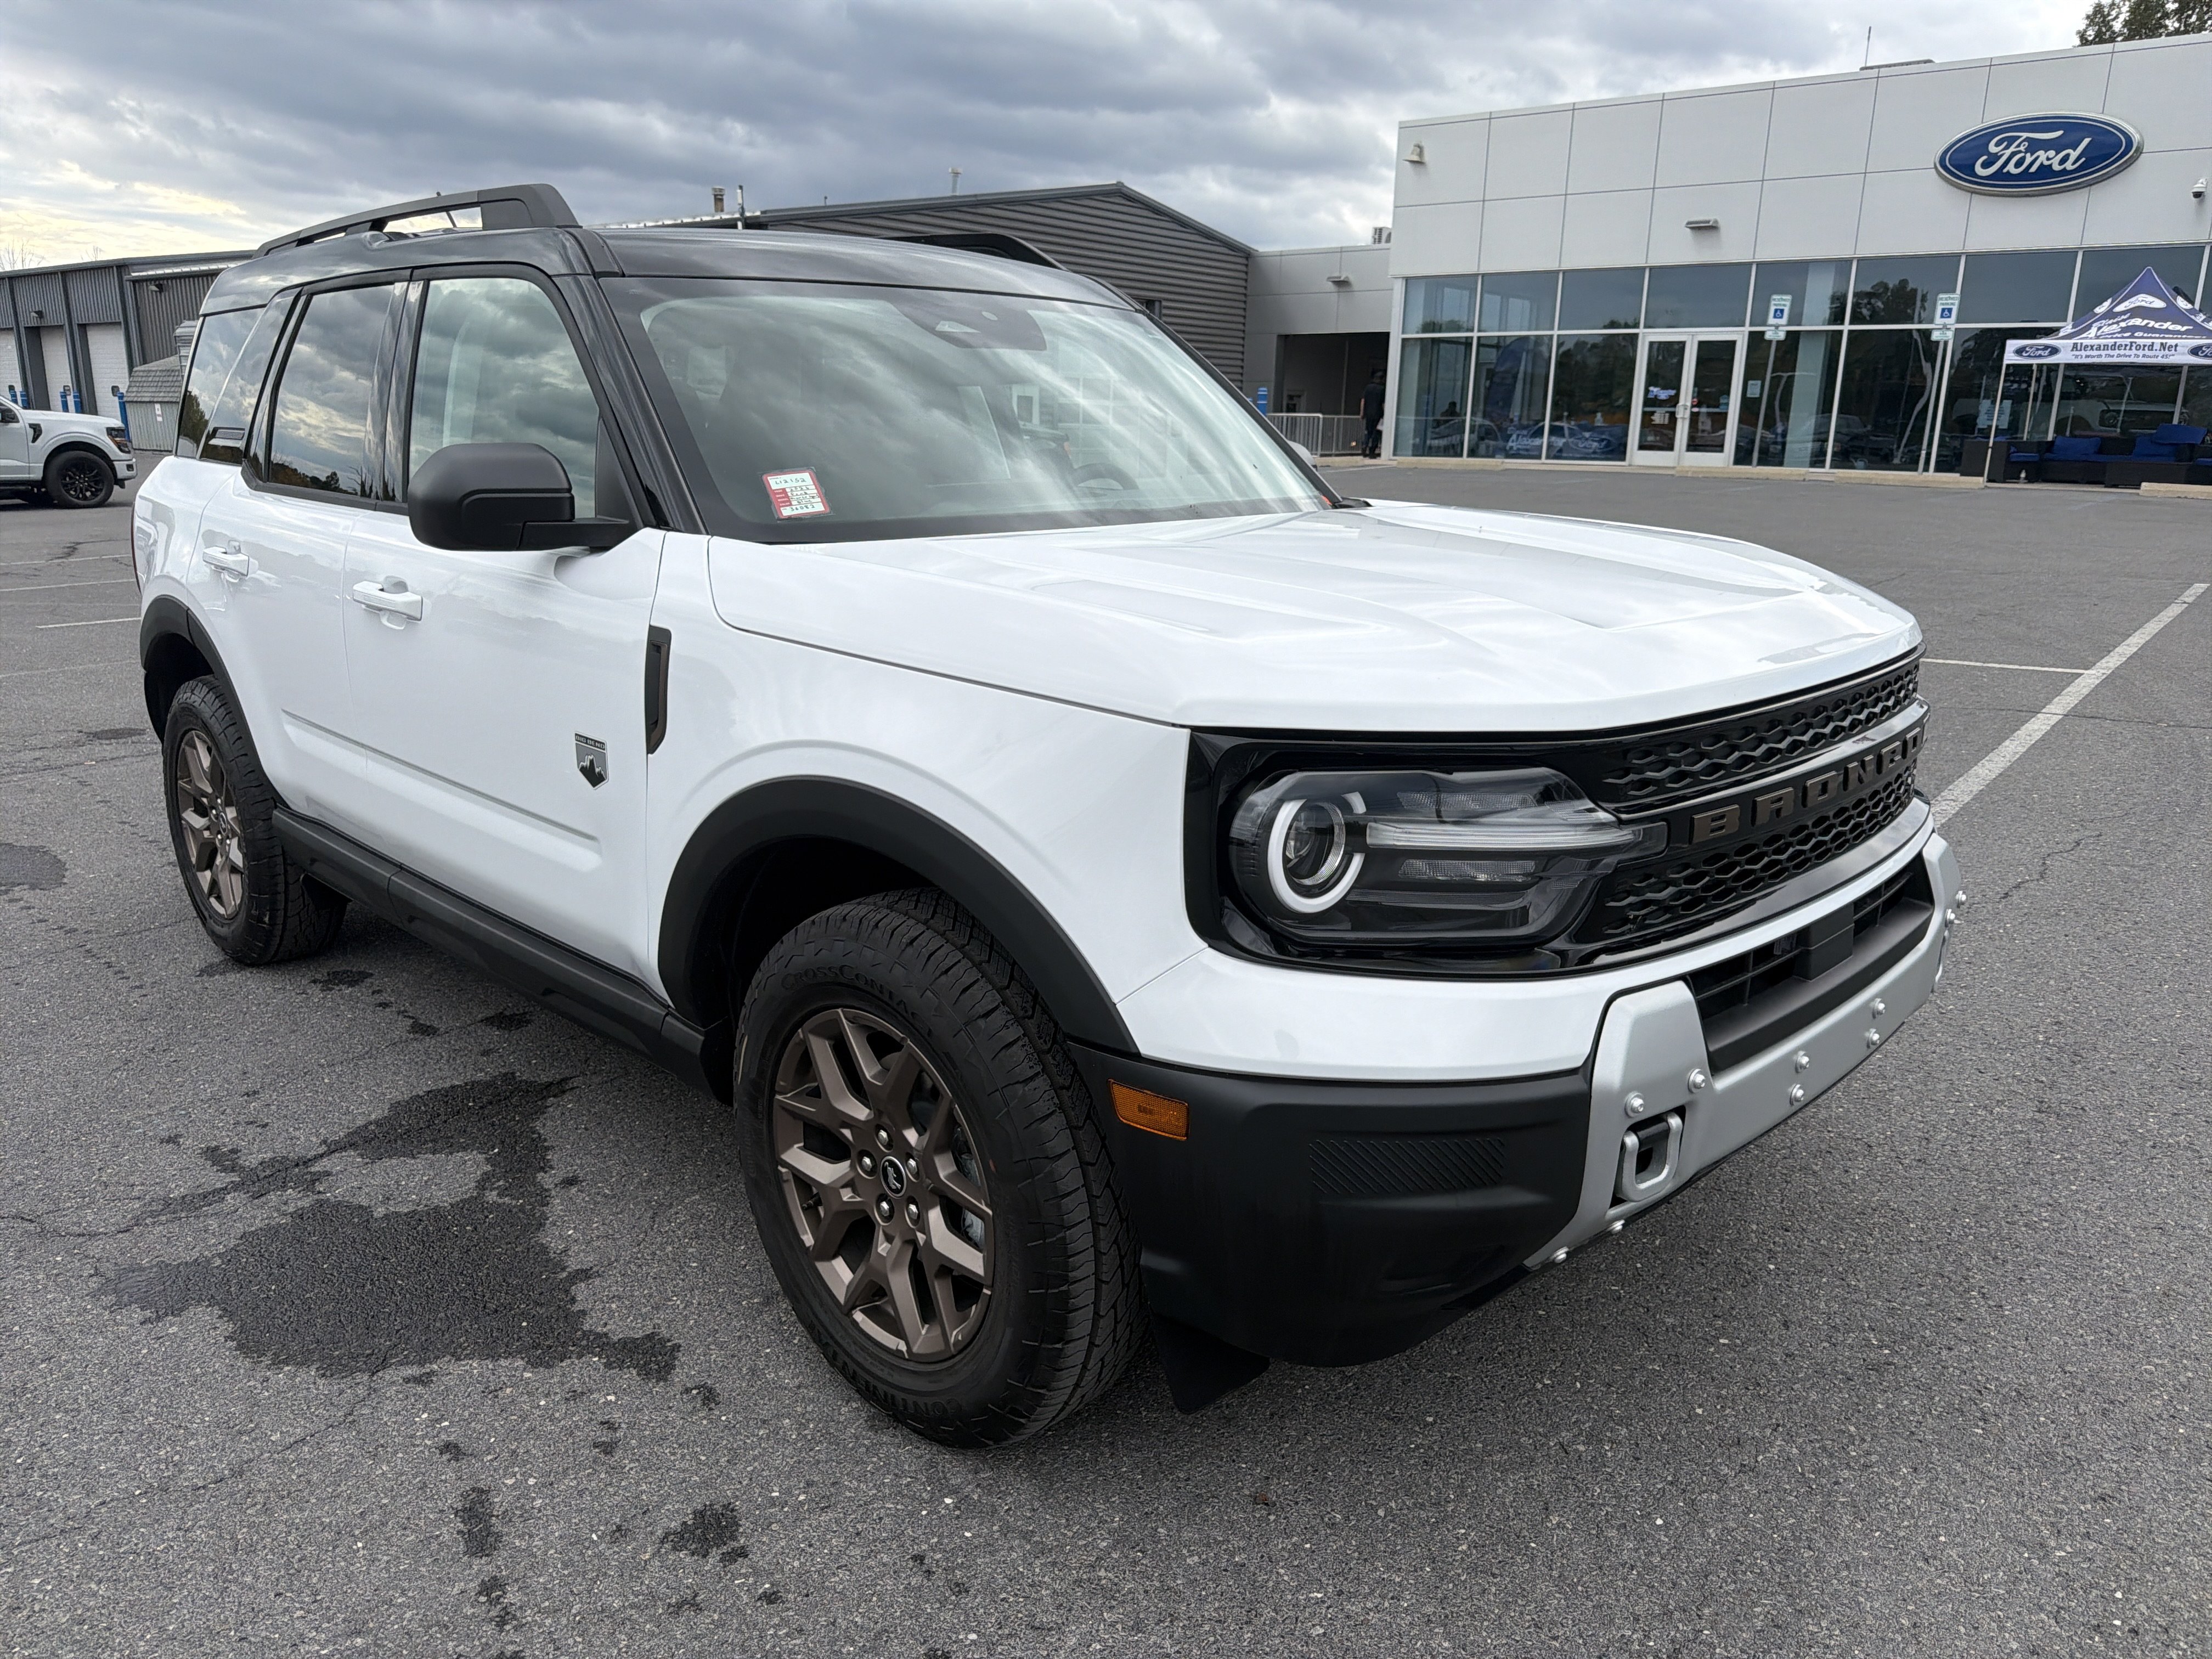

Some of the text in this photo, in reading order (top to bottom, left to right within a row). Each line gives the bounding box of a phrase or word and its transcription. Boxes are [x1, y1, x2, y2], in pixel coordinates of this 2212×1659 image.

[1975, 130, 2092, 176] Ford
[2072, 318, 2193, 340] Alexander
[2022, 346, 2051, 357] Ford
[2070, 341, 2179, 352] AlexanderFord.Net
[587, 739, 605, 749] BEND
[1690, 727, 1923, 844] BRONCO
